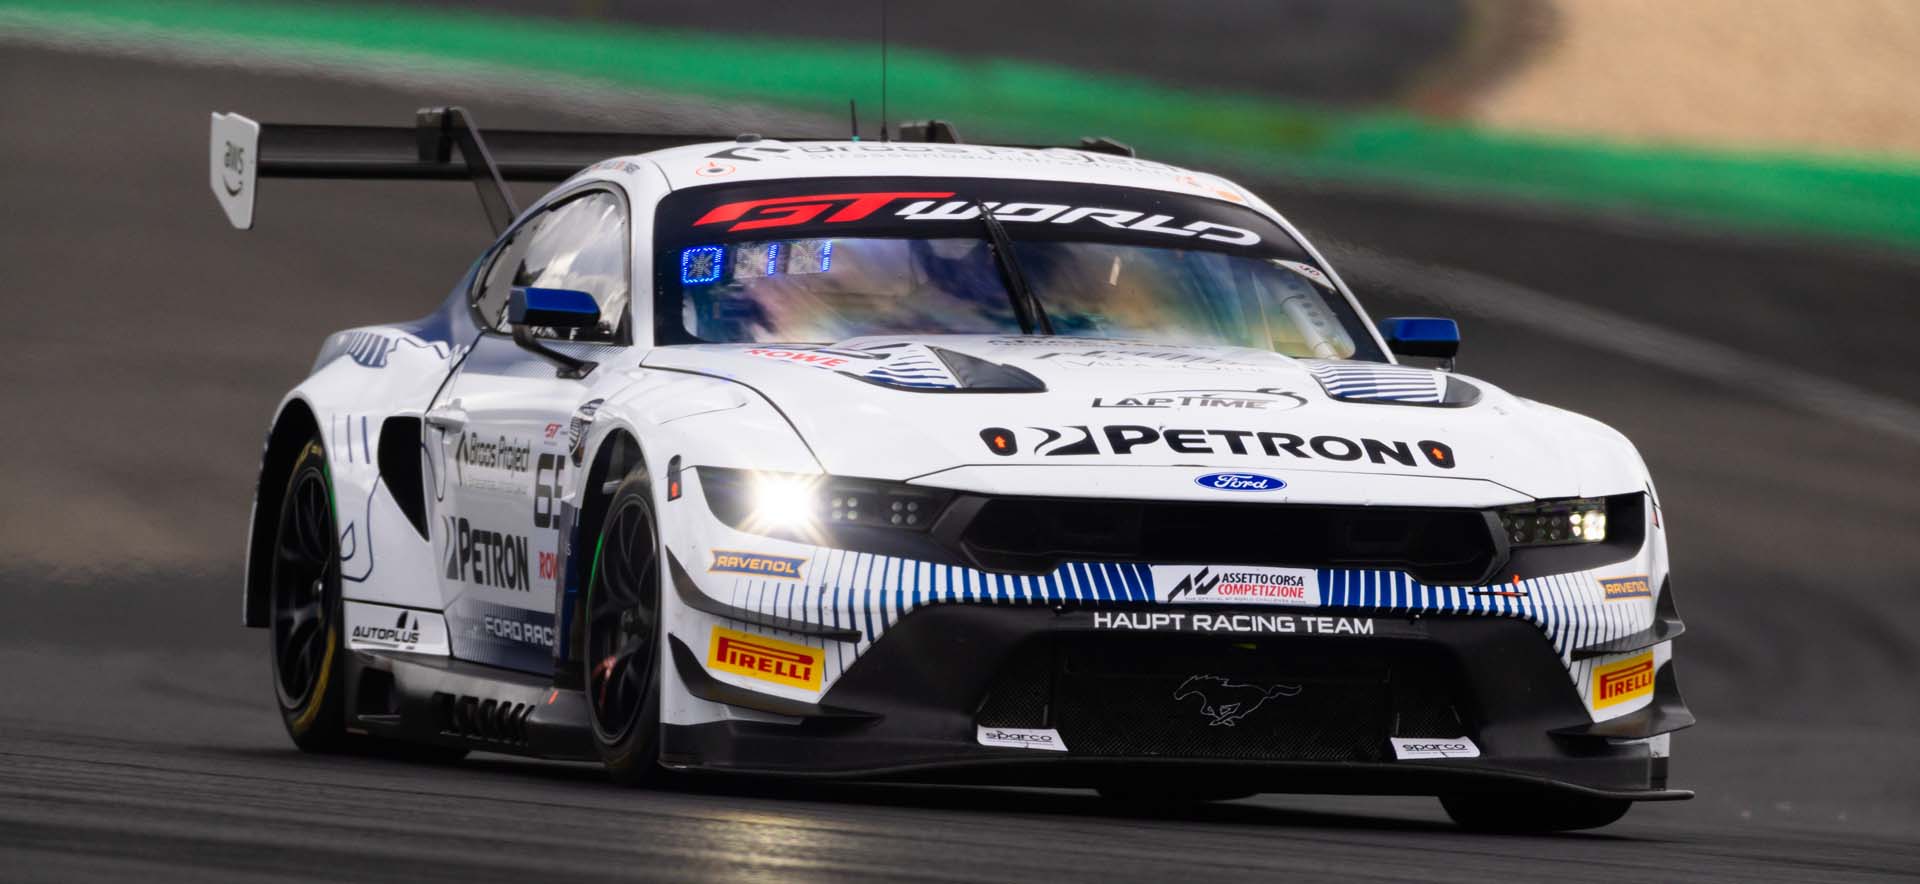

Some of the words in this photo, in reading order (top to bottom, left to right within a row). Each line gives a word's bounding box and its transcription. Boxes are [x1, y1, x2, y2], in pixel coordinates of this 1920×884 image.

[692, 192, 956, 232] GT
[894, 200, 1262, 246] WORLD
[744, 349, 849, 367] ROWE
[1102, 425, 1418, 467] PETRON
[498, 436, 531, 478] Project
[1212, 474, 1269, 490] Ford
[458, 517, 530, 593] PETRON
[716, 555, 796, 574] RAVENOL
[1221, 572, 1270, 585] ASSETTO
[1270, 574, 1304, 587] CORSA
[1217, 583, 1305, 599] COMPETIZIONE
[352, 624, 421, 644] AUTOPLUS
[484, 615, 523, 641] FORD
[523, 622, 554, 646] RAC
[1094, 612, 1185, 630] HAUPT
[1193, 614, 1297, 633] RACING
[1302, 616, 1375, 635] TEAM
[716, 636, 815, 681] PIRELLI
[1600, 660, 1654, 700] PIRELLI
[985, 730, 1054, 742] sparco
[1402, 743, 1467, 752] sparco
